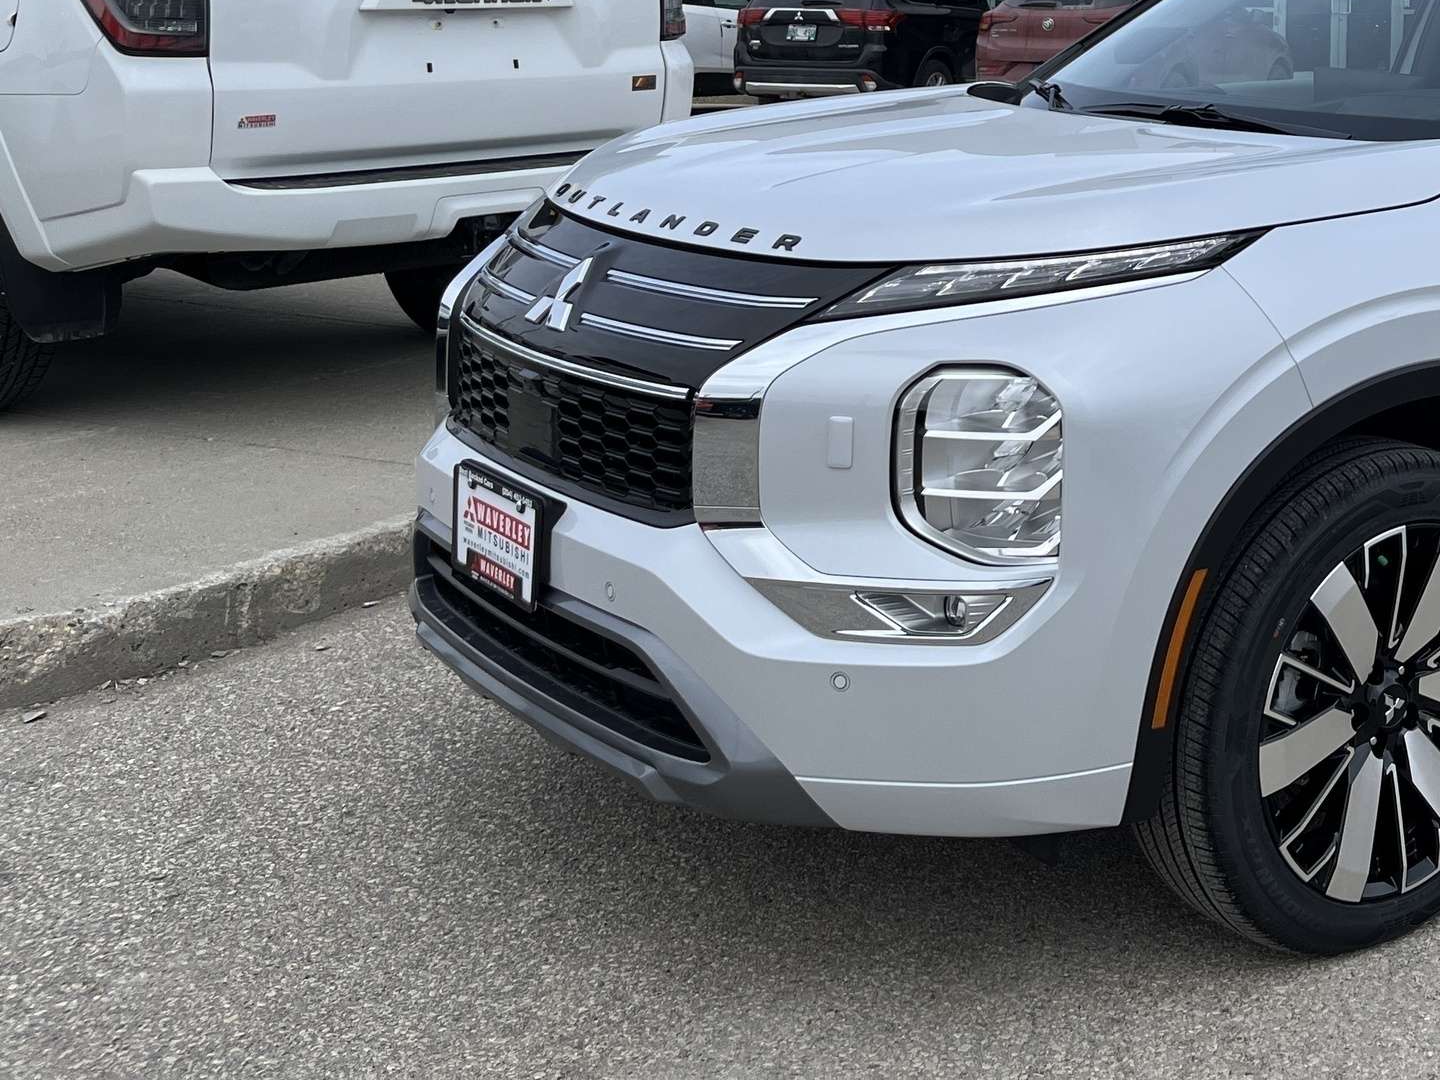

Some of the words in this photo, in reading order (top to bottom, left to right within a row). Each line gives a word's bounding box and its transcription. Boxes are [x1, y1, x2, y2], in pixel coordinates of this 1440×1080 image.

[556, 183, 802, 252] OUTLANDER
[476, 501, 531, 547] WAVERLEY
[477, 525, 529, 566] MITSUBISHI
[480, 559, 515, 589] WAVERLEY
